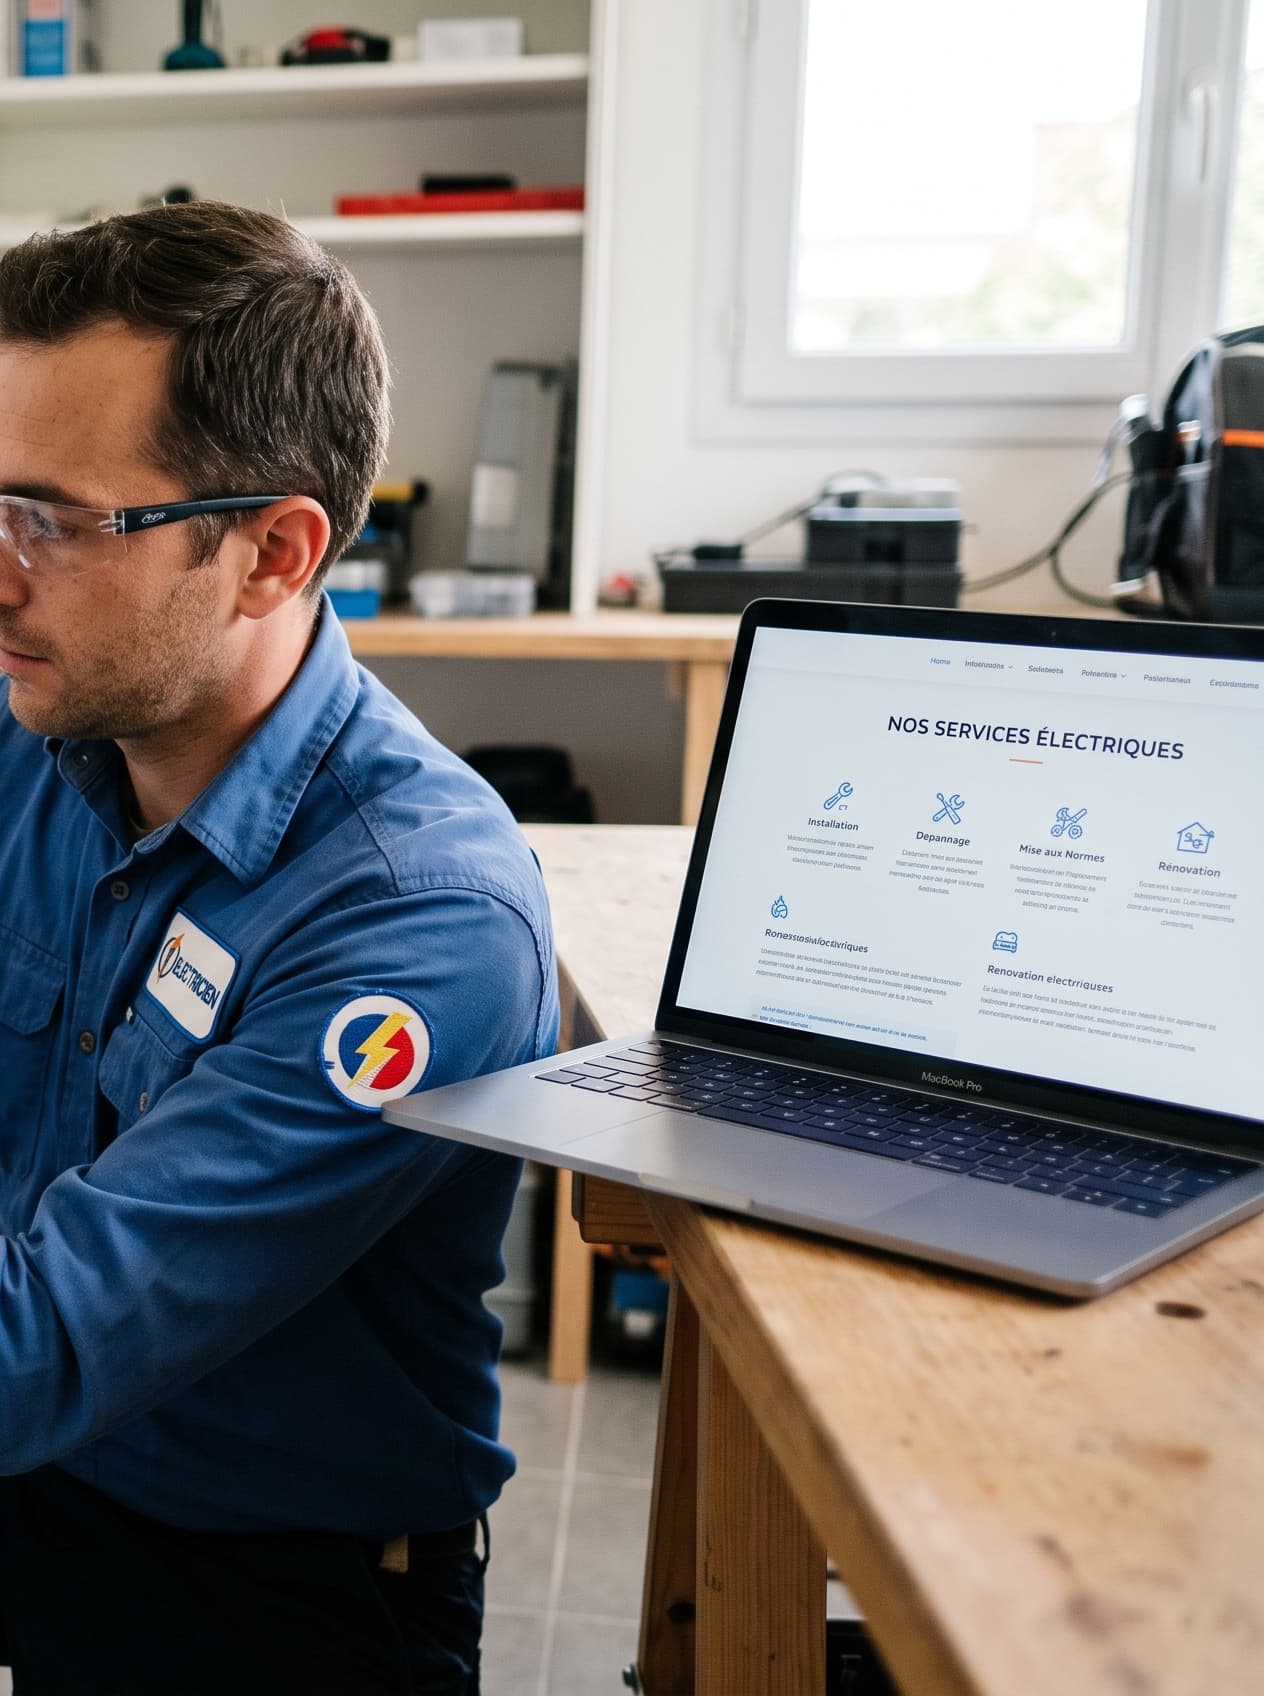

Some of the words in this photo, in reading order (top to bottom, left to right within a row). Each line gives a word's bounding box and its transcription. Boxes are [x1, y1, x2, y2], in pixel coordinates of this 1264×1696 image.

[887, 716, 929, 735] NOS
[934, 720, 1031, 745] SERVICES
[1036, 726, 1184, 760] ÉLECTRIQUES
[808, 817, 859, 831] Installation
[916, 831, 971, 847] Depannage
[1018, 844, 1042, 857] Mise
[1044, 848, 1063, 858] aux
[1065, 850, 1106, 863] Normes
[987, 964, 1044, 982] Renovation
[921, 1071, 965, 1089] MacBook
[966, 1080, 982, 1092] Pro
